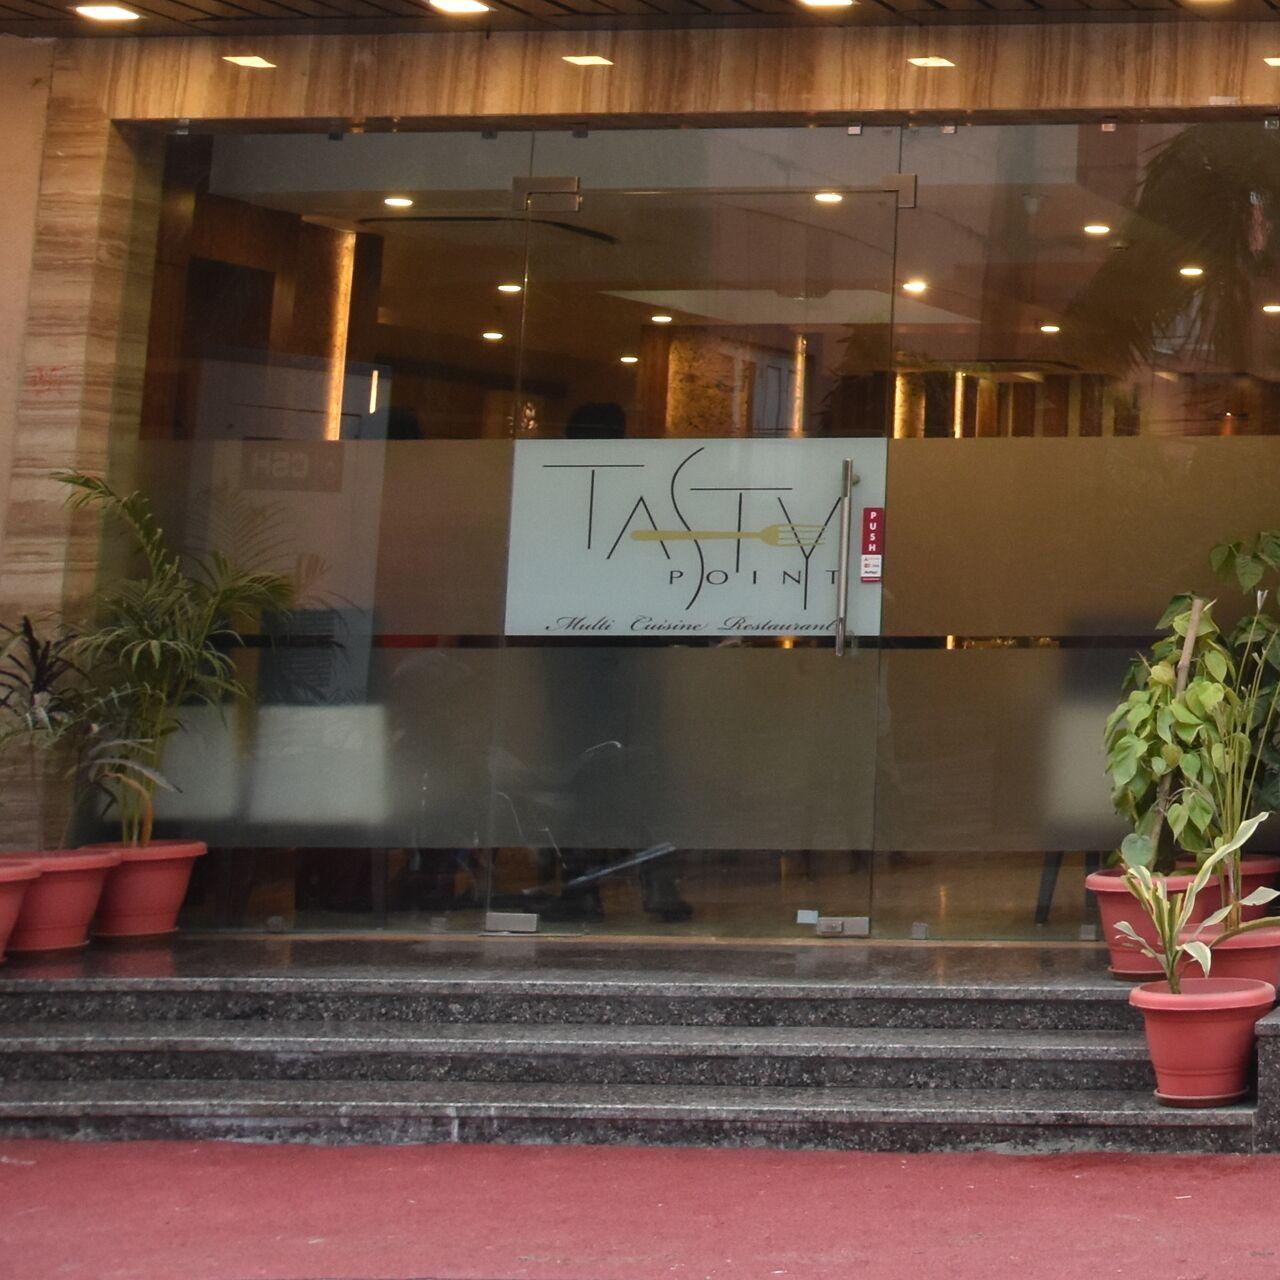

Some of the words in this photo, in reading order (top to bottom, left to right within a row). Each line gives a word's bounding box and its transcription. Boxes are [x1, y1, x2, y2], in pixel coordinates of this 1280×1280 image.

[542, 447, 842, 610] TASTY
[868, 511, 877, 552] PUSH
[669, 570, 840, 585] POINT
[546, 616, 615, 632] Multi
[630, 615, 706, 632] Cuisine
[718, 616, 839, 632] Restaurant
